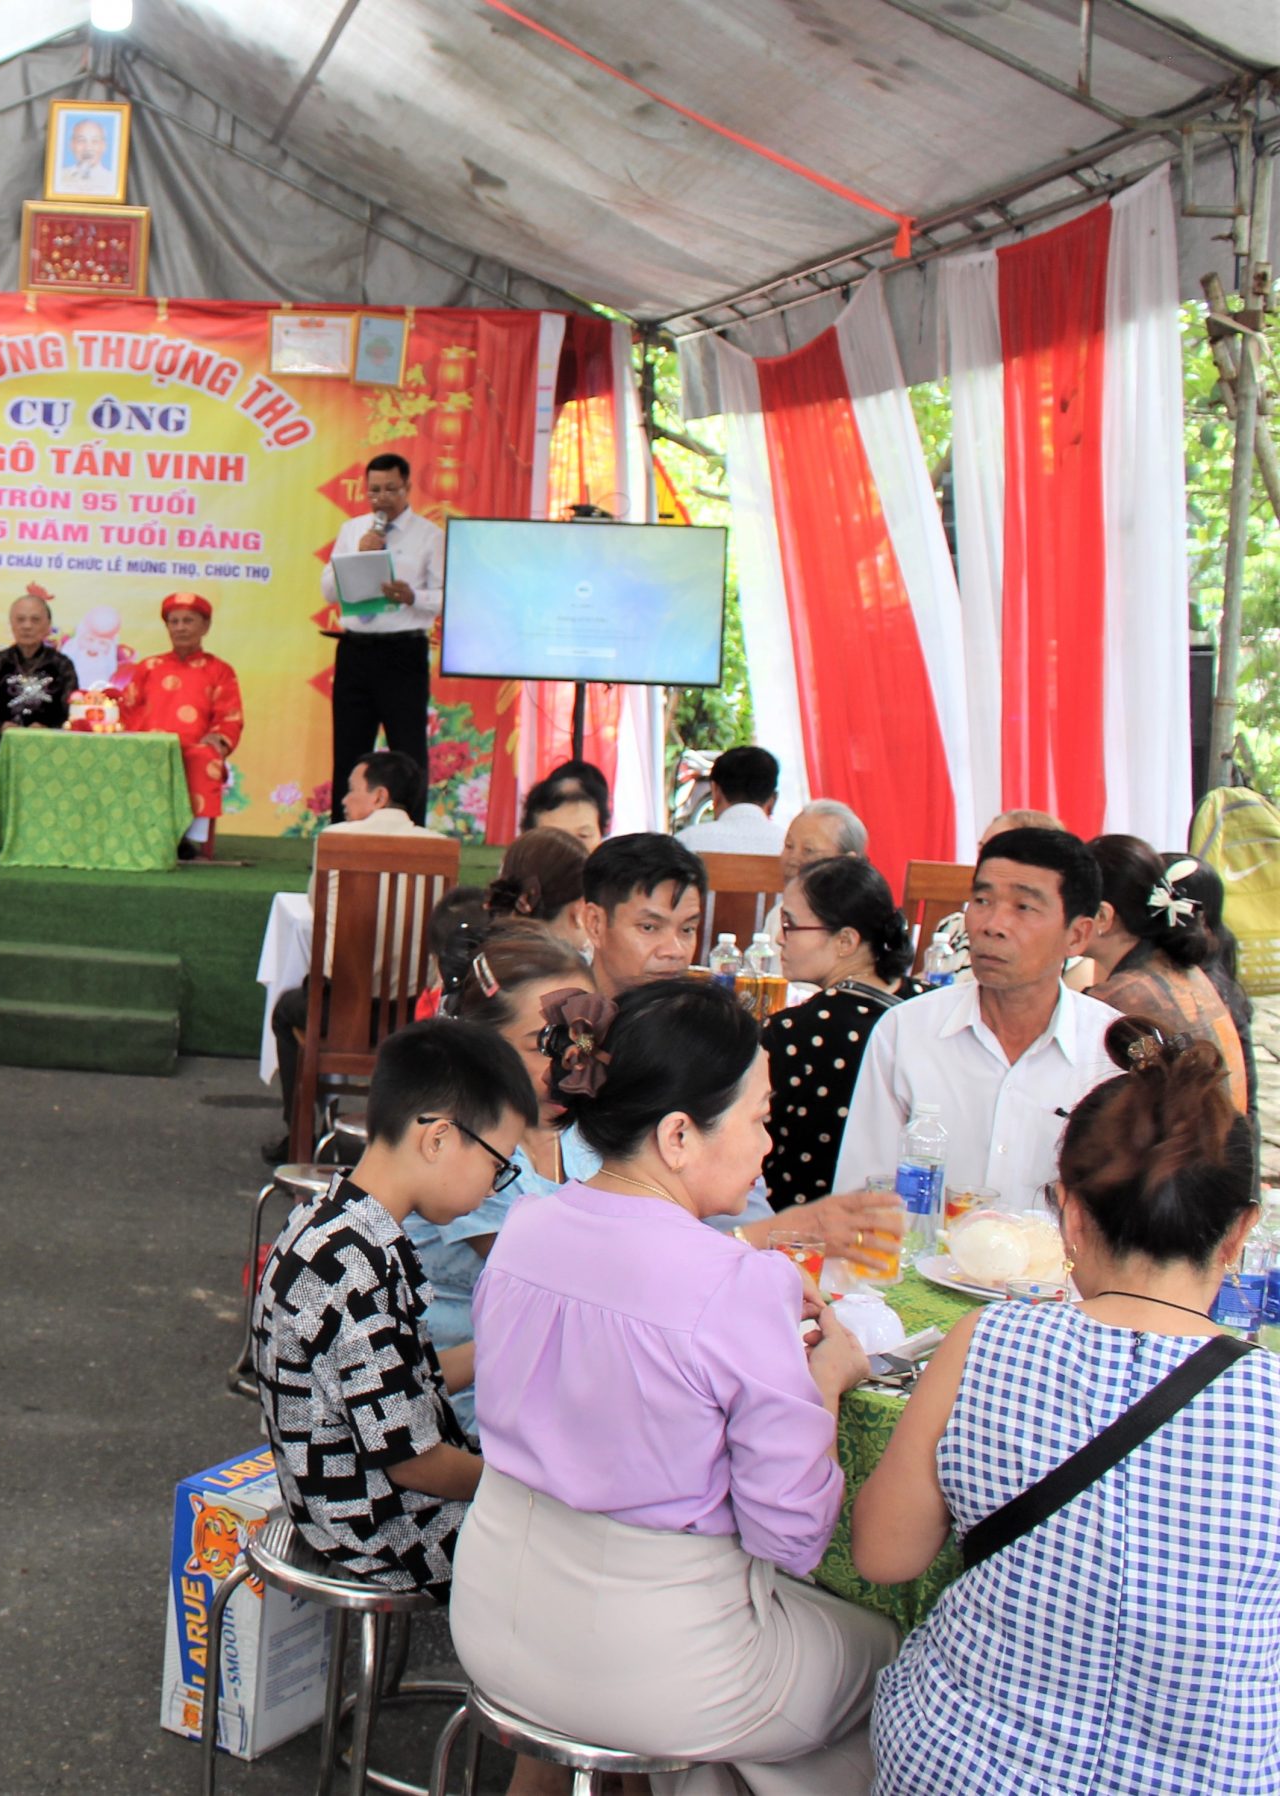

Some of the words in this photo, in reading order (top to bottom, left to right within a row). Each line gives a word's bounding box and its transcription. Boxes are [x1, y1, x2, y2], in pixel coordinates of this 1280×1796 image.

[78, 335, 239, 396] THƯỢNG
[240, 378, 311, 448] THỌ
[10, 399, 70, 434] CỤ
[91, 396, 187, 432] ÔNG
[50, 439, 131, 477] TẤN
[146, 452, 244, 482] VINH
[82, 492, 118, 512] 95
[128, 487, 196, 515] TUỔI
[18, 517, 89, 543] NĂM
[99, 520, 167, 546] TUỔI
[177, 523, 262, 551] ĐẢNG
[7, 551, 43, 568] CHÁU
[67, 552, 102, 571] CHỨC
[126, 557, 167, 574] MỪNG
[205, 561, 240, 577] CHÚC
[245, 565, 270, 582] THỌ
[202, 1450, 276, 1489] LARU
